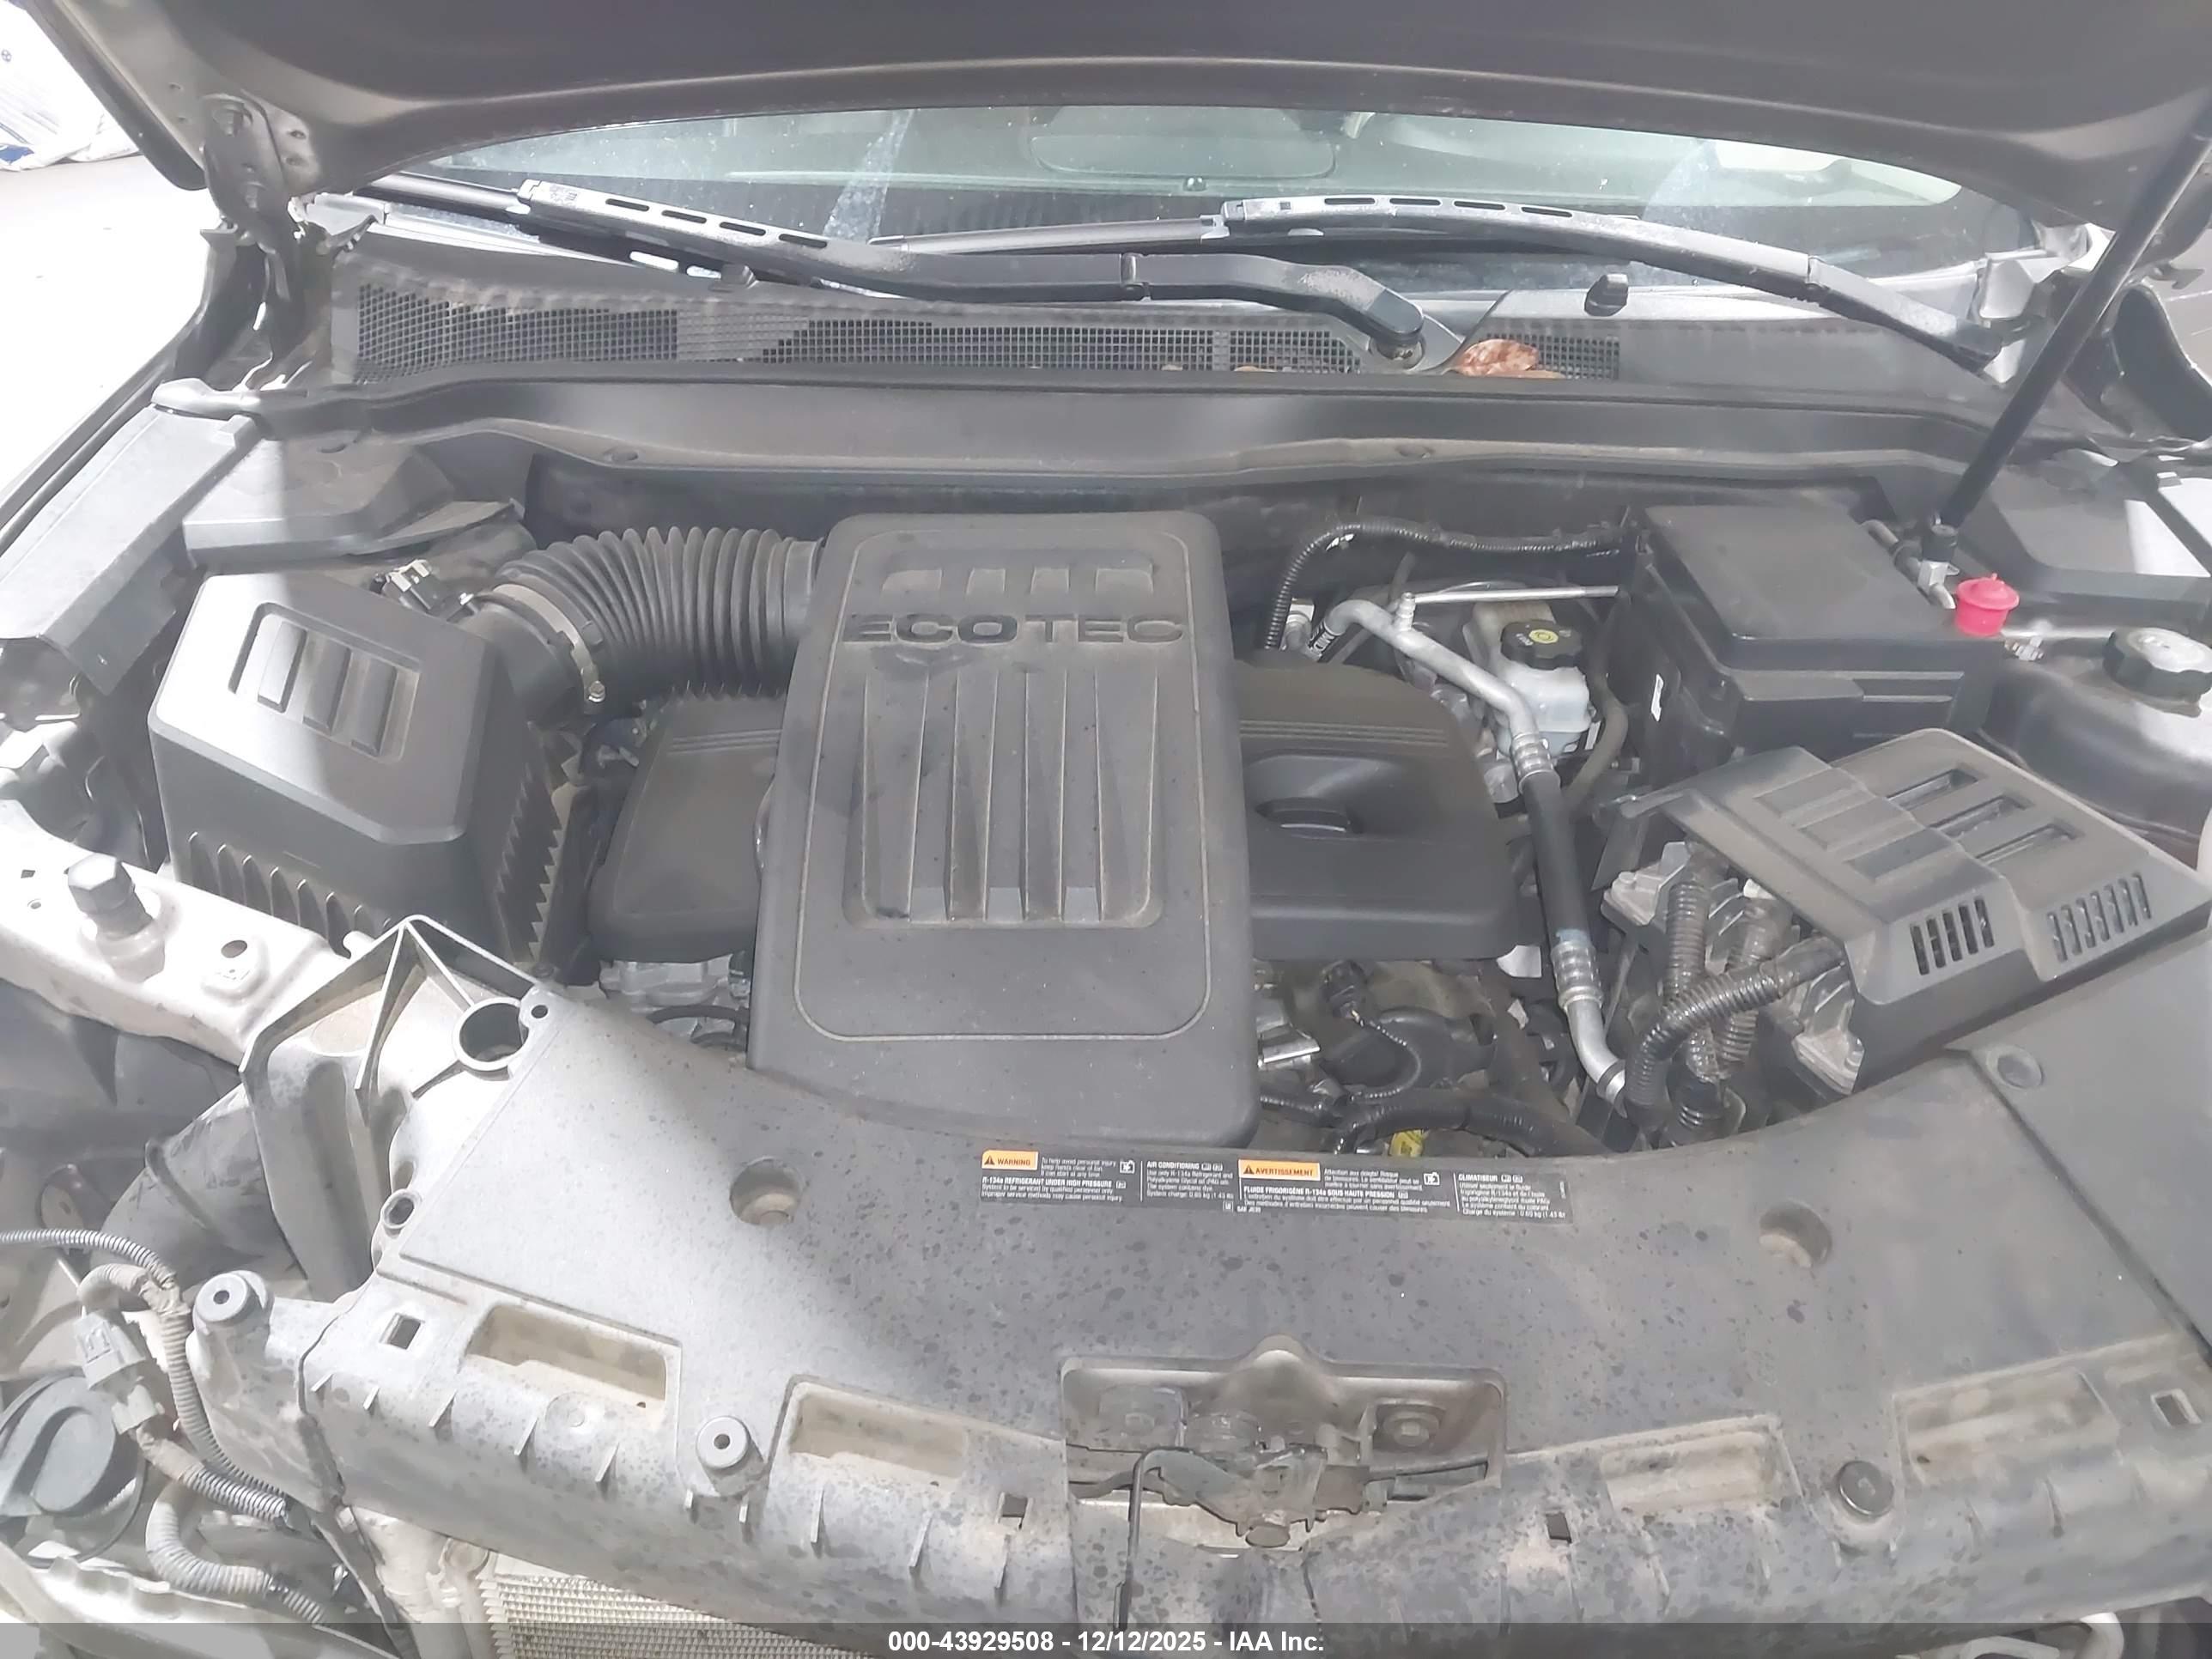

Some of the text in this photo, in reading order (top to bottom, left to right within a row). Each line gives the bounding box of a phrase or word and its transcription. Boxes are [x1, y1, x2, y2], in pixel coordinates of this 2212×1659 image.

[843, 612, 1184, 646] ECOTEC
[997, 1158, 1031, 1166] WARNING
[1158, 1161, 1200, 1170] CONDITIONING
[1255, 1167, 1313, 1176] AVERTISSEMENT
[1045, 1178, 1066, 1187] UNDER
[1458, 1174, 1498, 1182] CLIMATISEUR
[1243, 1185, 1265, 1194] FLUIDE
[1327, 1188, 1343, 1197] SOUS
[1364, 1190, 1395, 1199] PRESSION
